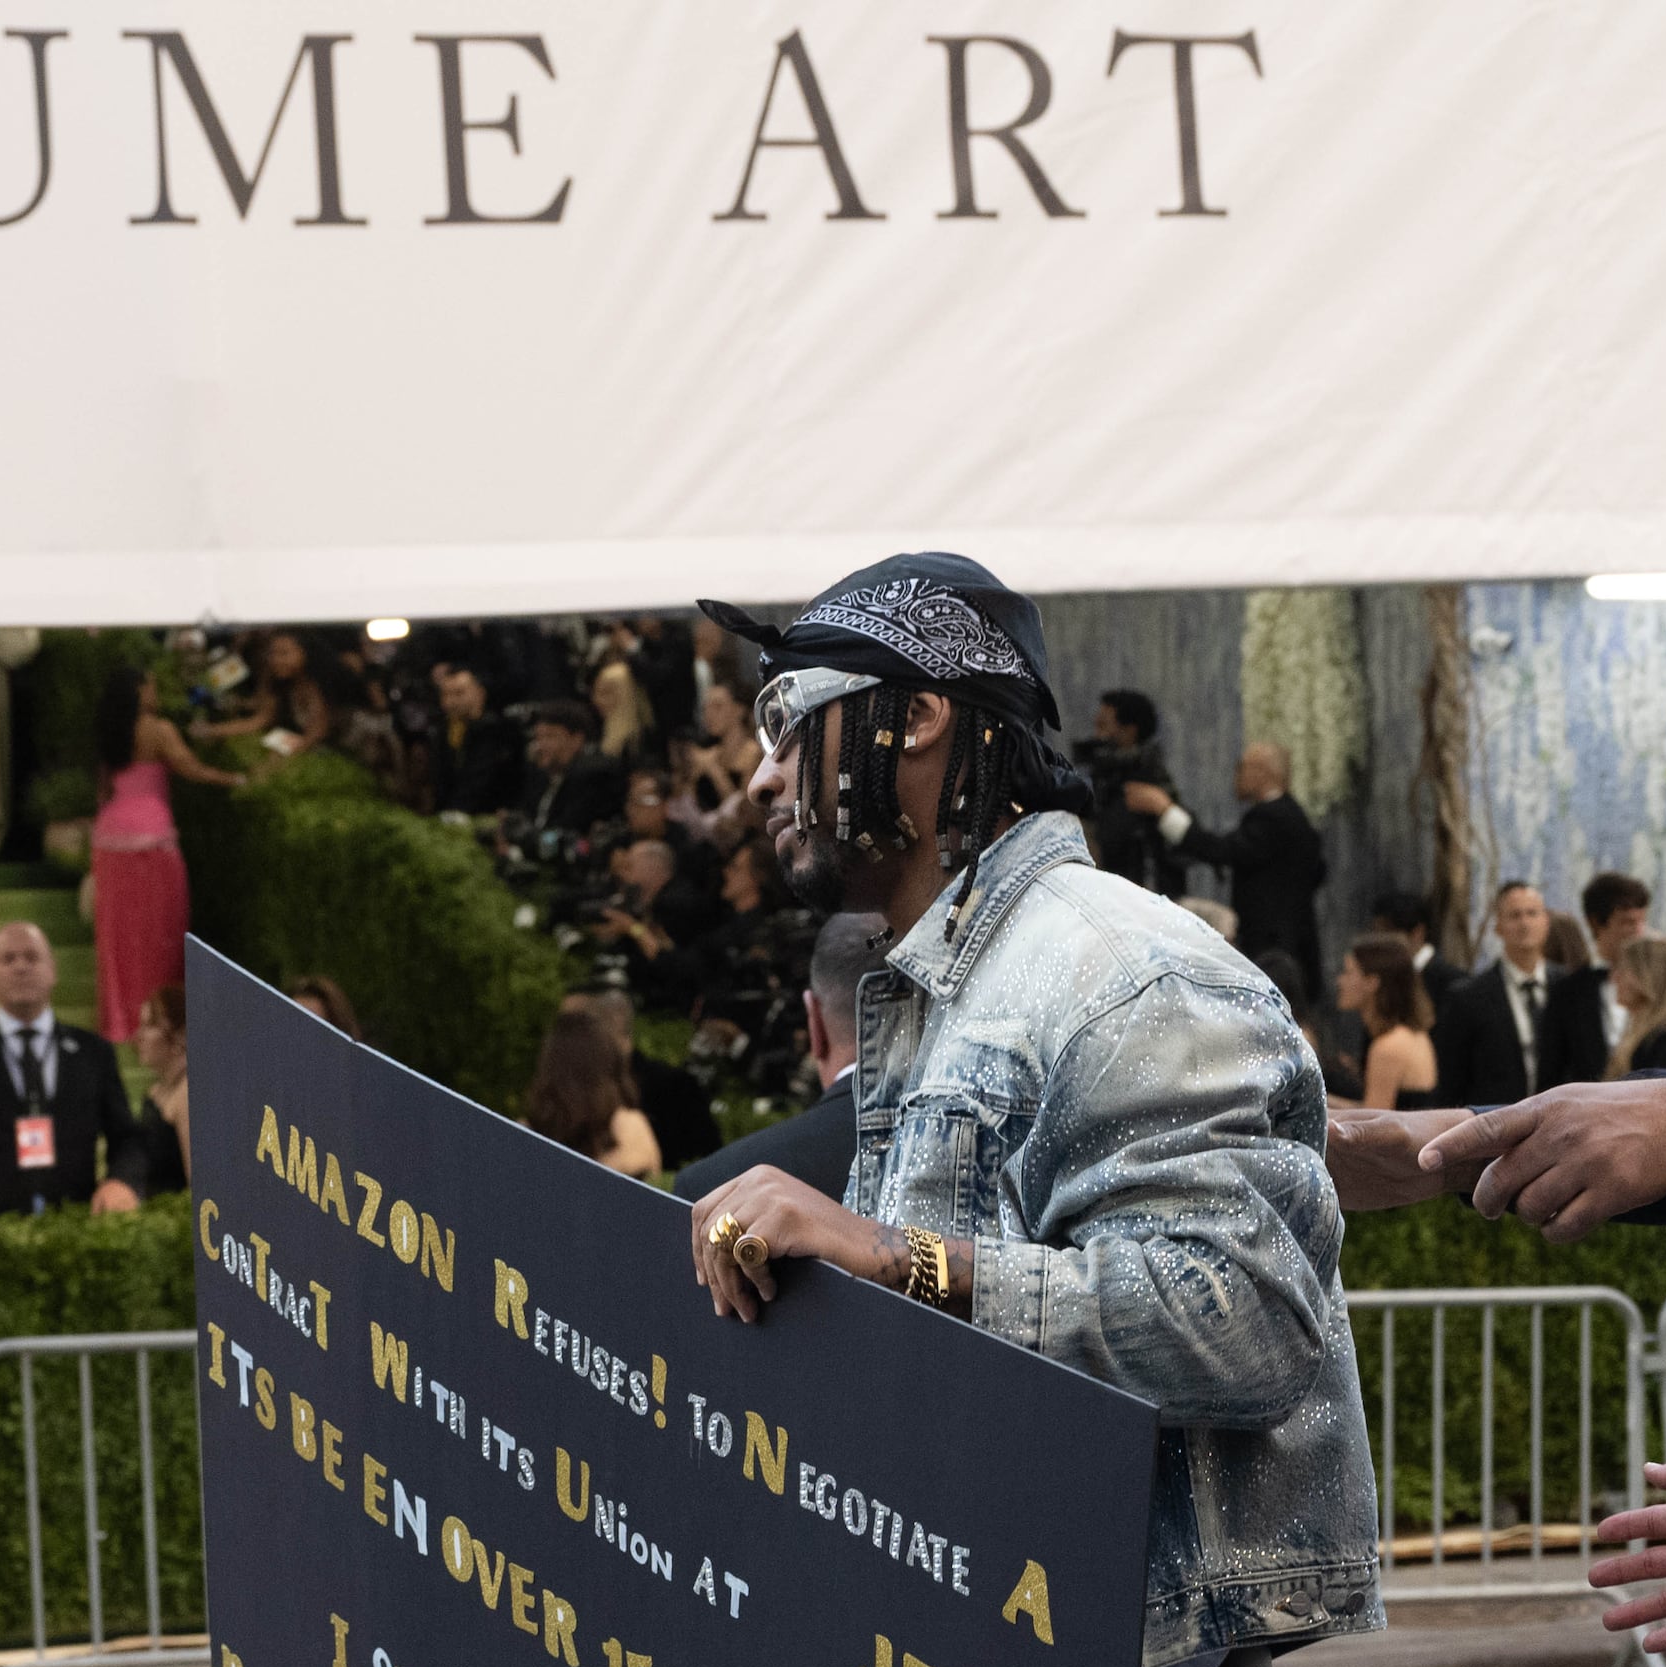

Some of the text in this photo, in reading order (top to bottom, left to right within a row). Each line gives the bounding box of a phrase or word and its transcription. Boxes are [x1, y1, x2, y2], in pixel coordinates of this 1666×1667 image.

[712, 28, 1264, 220] ART
[199, 1198, 332, 1351] CONTRACT
[370, 1321, 466, 1439] WITH
[481, 1417, 535, 1490] ITS
[693, 1556, 750, 1619] AT
[207, 1321, 277, 1430] ITS
[256, 1105, 1055, 1646] AMAZON REFUSES! TO NEGOTIATE A
